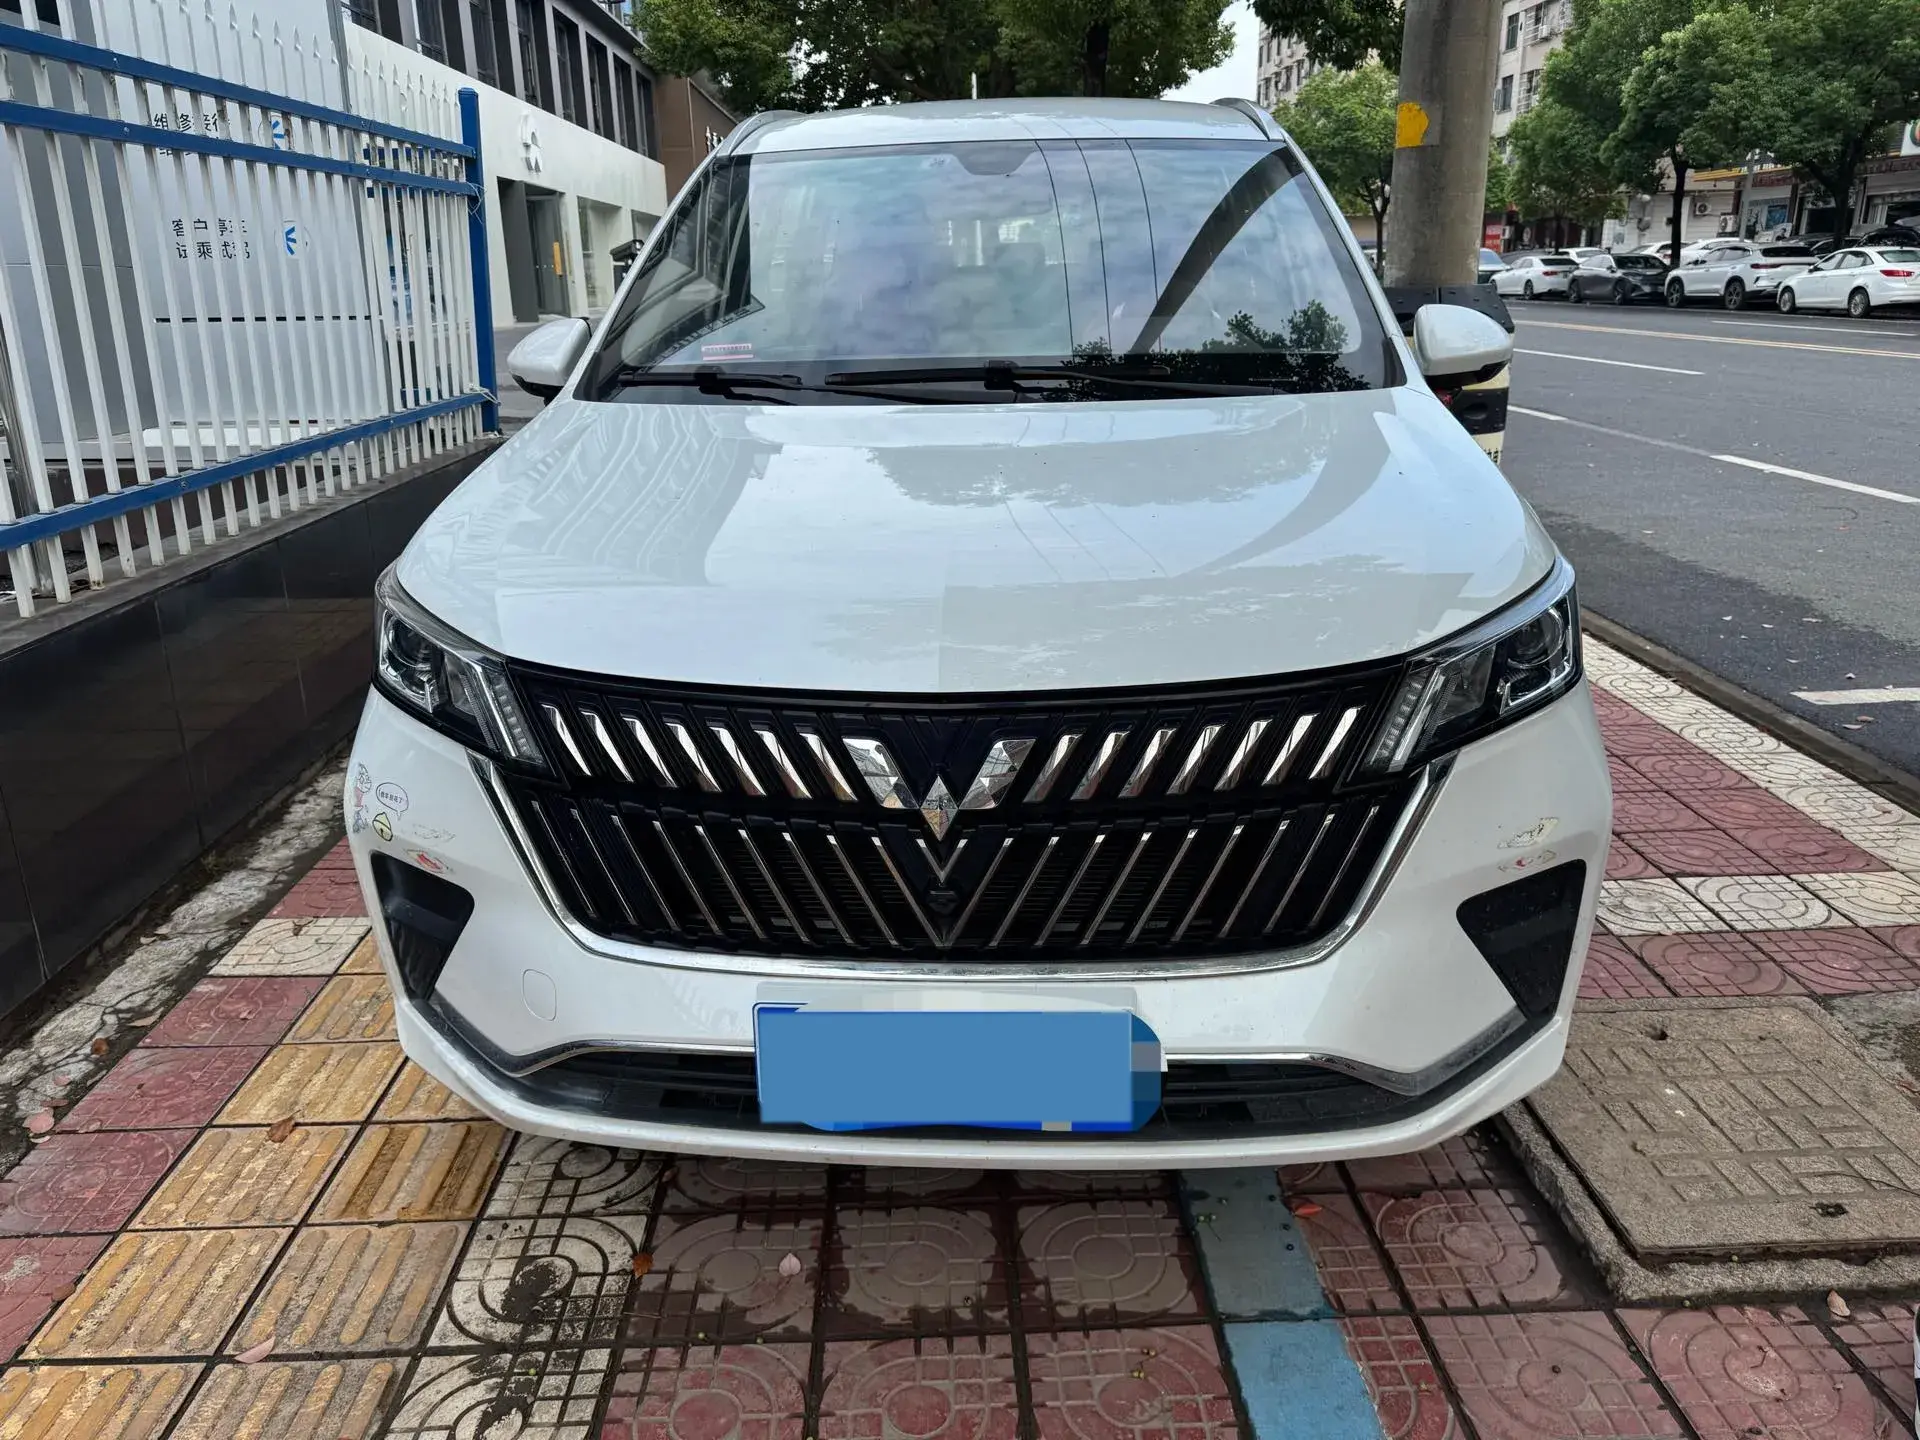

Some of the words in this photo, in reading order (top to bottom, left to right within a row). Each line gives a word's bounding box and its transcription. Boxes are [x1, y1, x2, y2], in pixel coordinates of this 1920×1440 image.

[172, 218, 248, 236] 客户停
[176, 241, 251, 260] 试乘试
